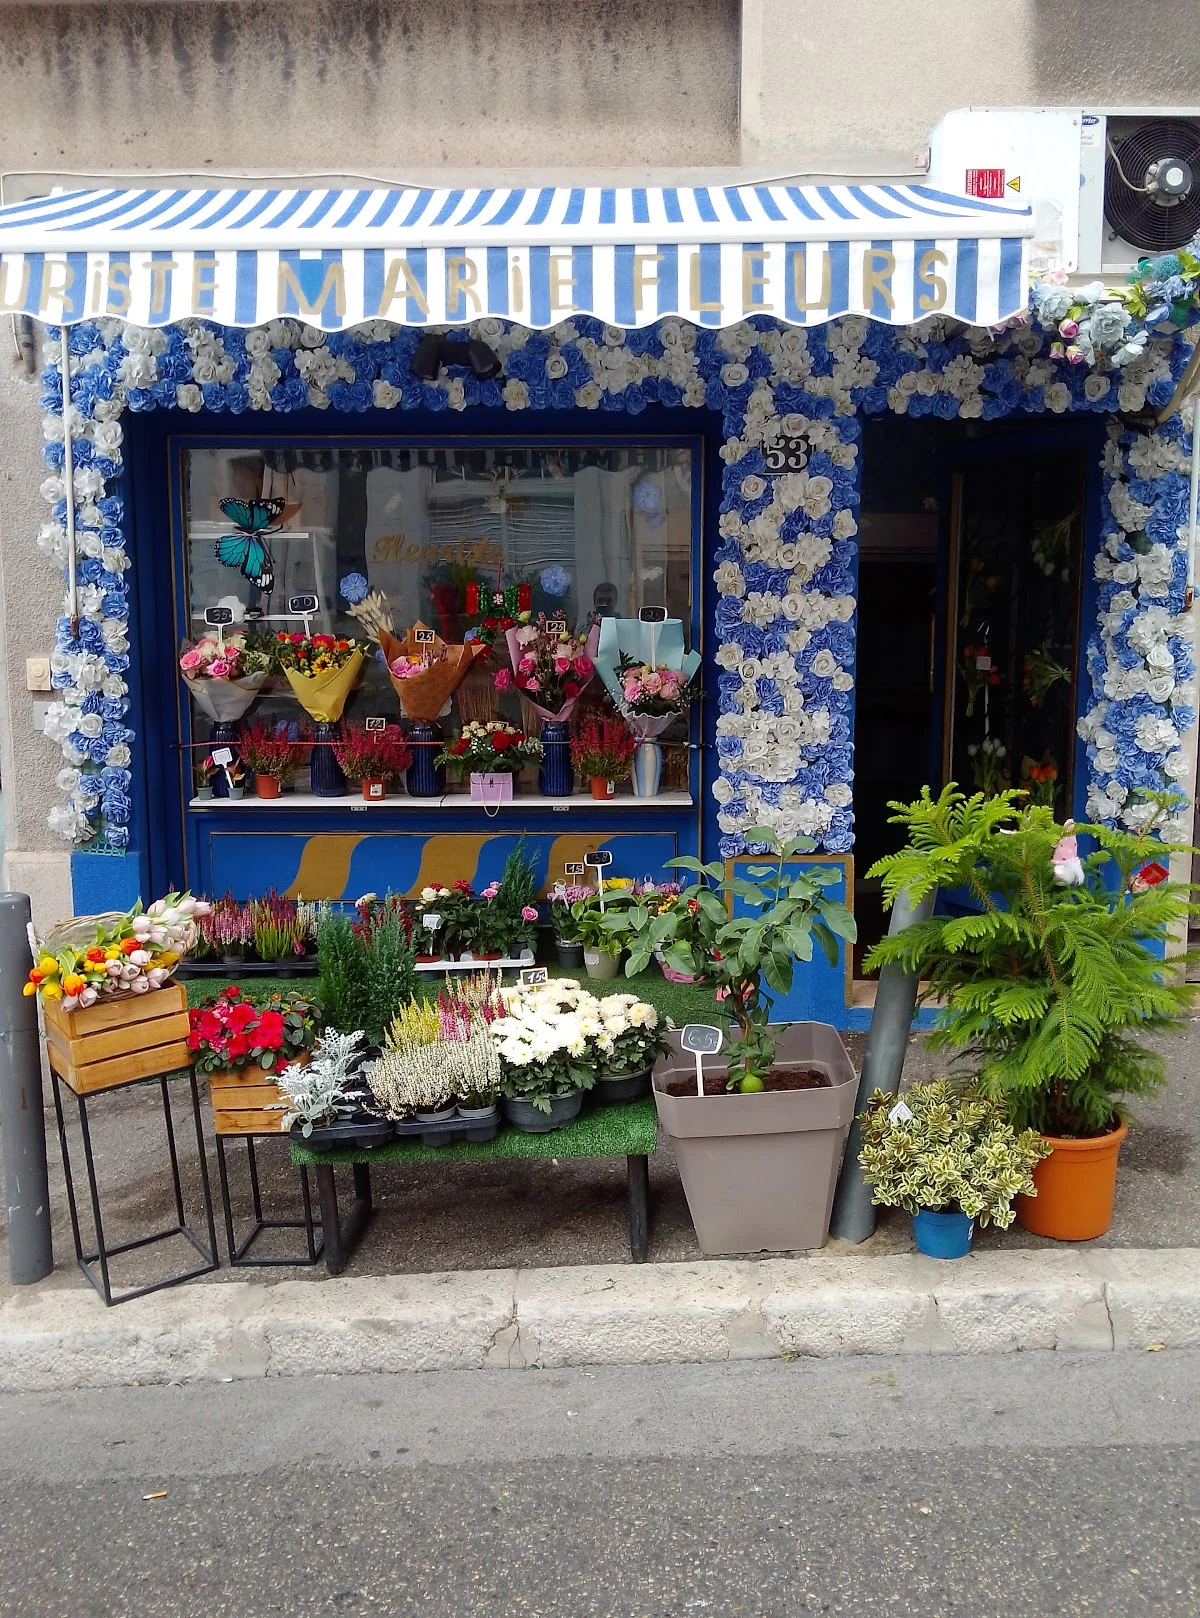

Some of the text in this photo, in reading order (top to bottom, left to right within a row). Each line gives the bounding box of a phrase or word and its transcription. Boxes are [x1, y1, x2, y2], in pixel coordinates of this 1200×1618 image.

[633, 249, 949, 312] FLEURS
[766, 439, 808, 469] 53
[418, 631, 433, 641] 25
